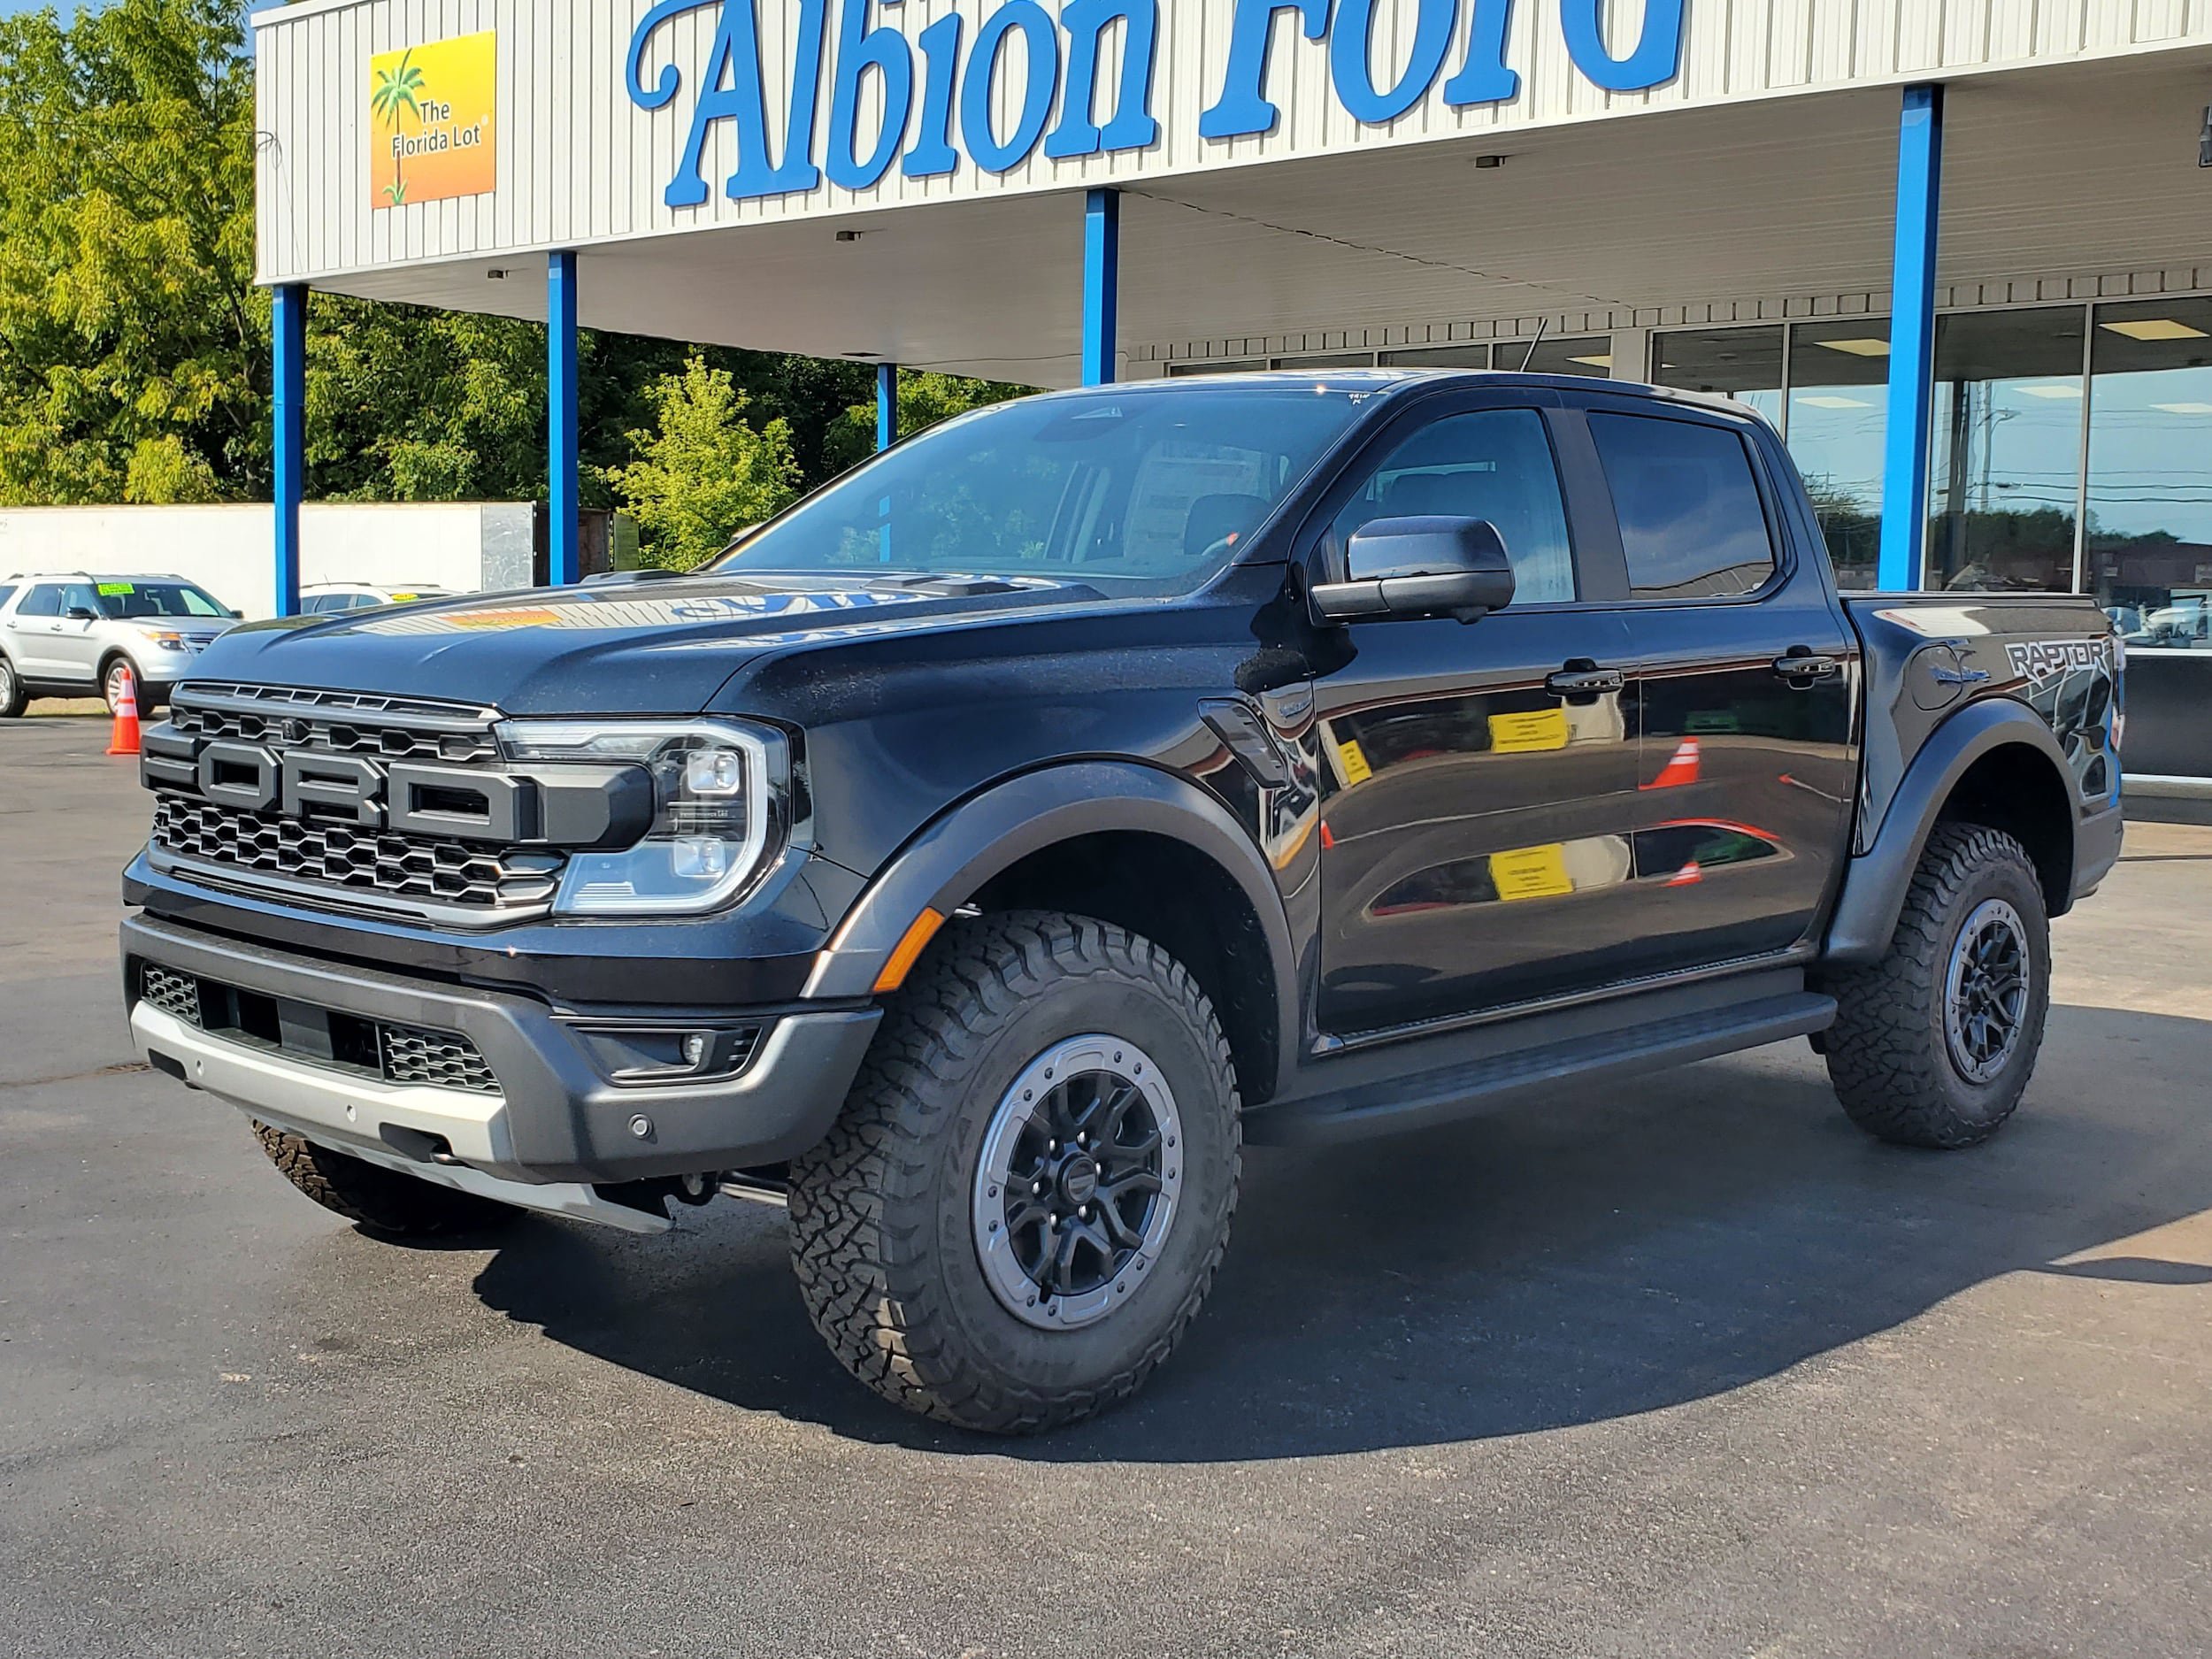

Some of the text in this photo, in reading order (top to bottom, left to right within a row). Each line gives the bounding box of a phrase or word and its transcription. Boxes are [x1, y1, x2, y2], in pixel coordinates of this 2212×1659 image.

[419, 99, 449, 124] The
[626, 0, 1156, 207] Albion
[392, 124, 480, 158] Florida Lot
[2005, 639, 2109, 689] RAPTOR
[140, 731, 537, 842] FORD
